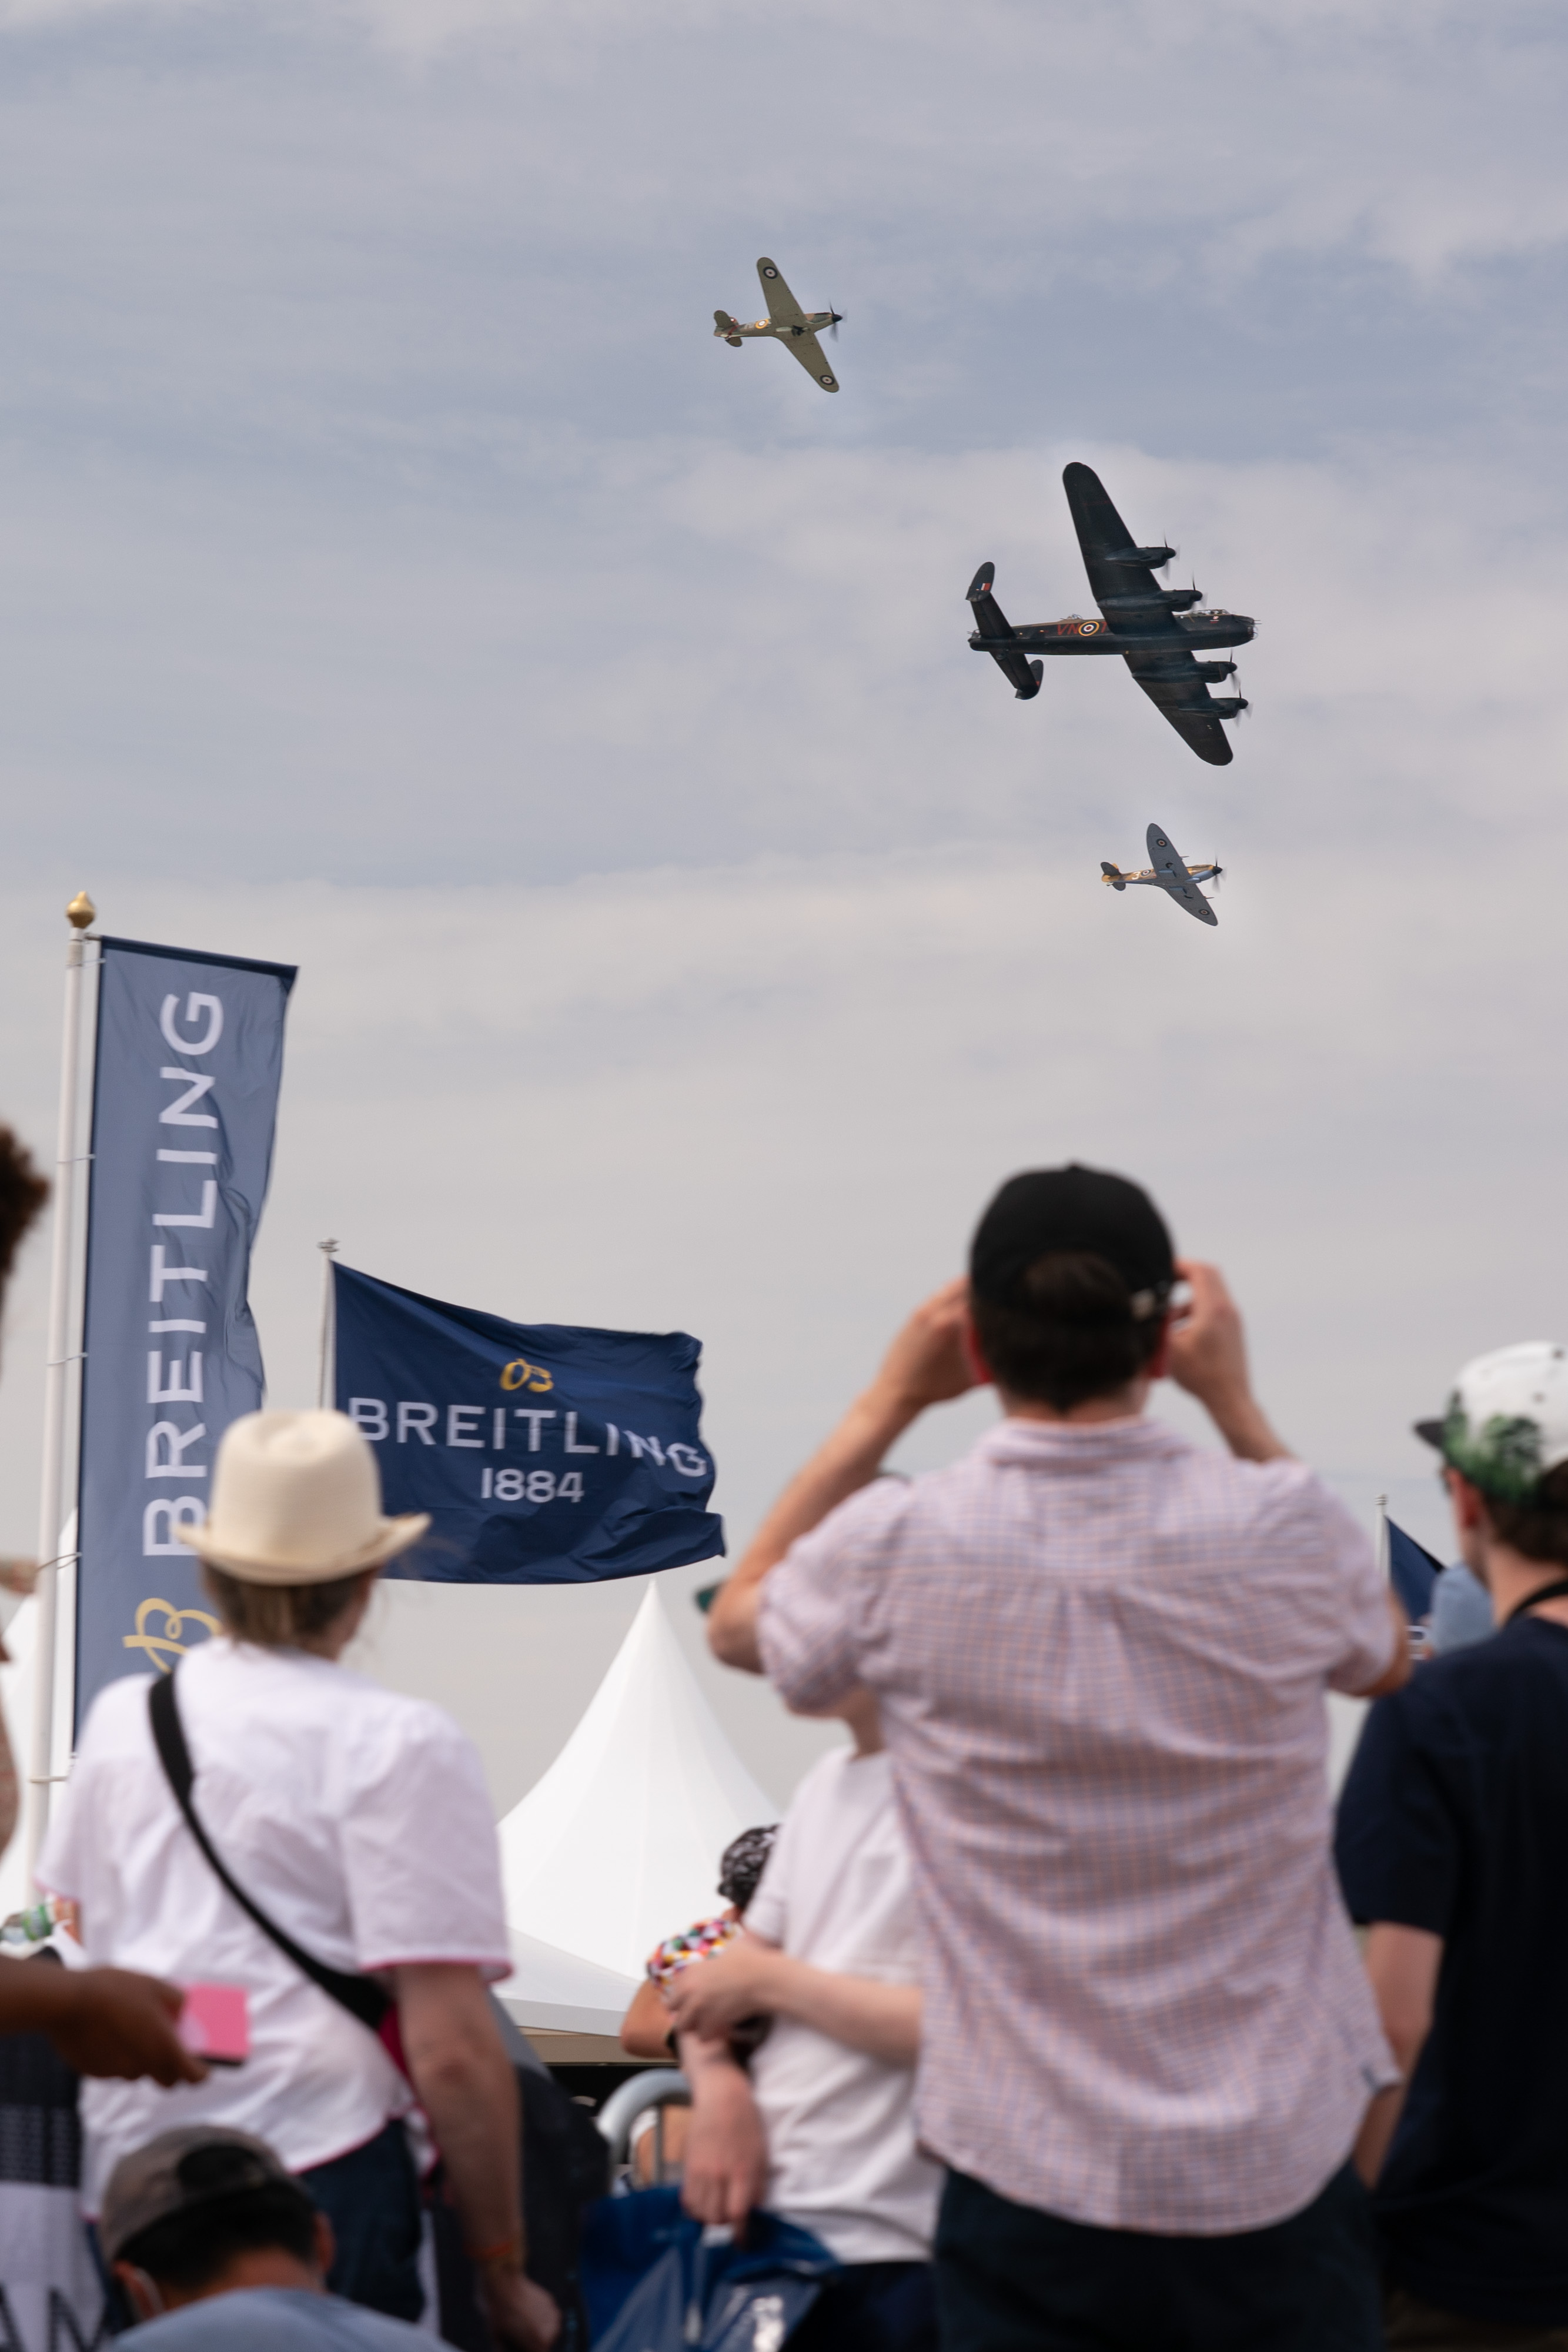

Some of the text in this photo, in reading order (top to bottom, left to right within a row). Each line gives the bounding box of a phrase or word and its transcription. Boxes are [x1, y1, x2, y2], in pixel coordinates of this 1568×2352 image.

[1057, 623, 1080, 635] VN
[1132, 871, 1141, 880] 3
[143, 992, 224, 1556] BREITLING
[348, 1397, 707, 1476] BREITLING
[482, 1468, 584, 1503] 1884
